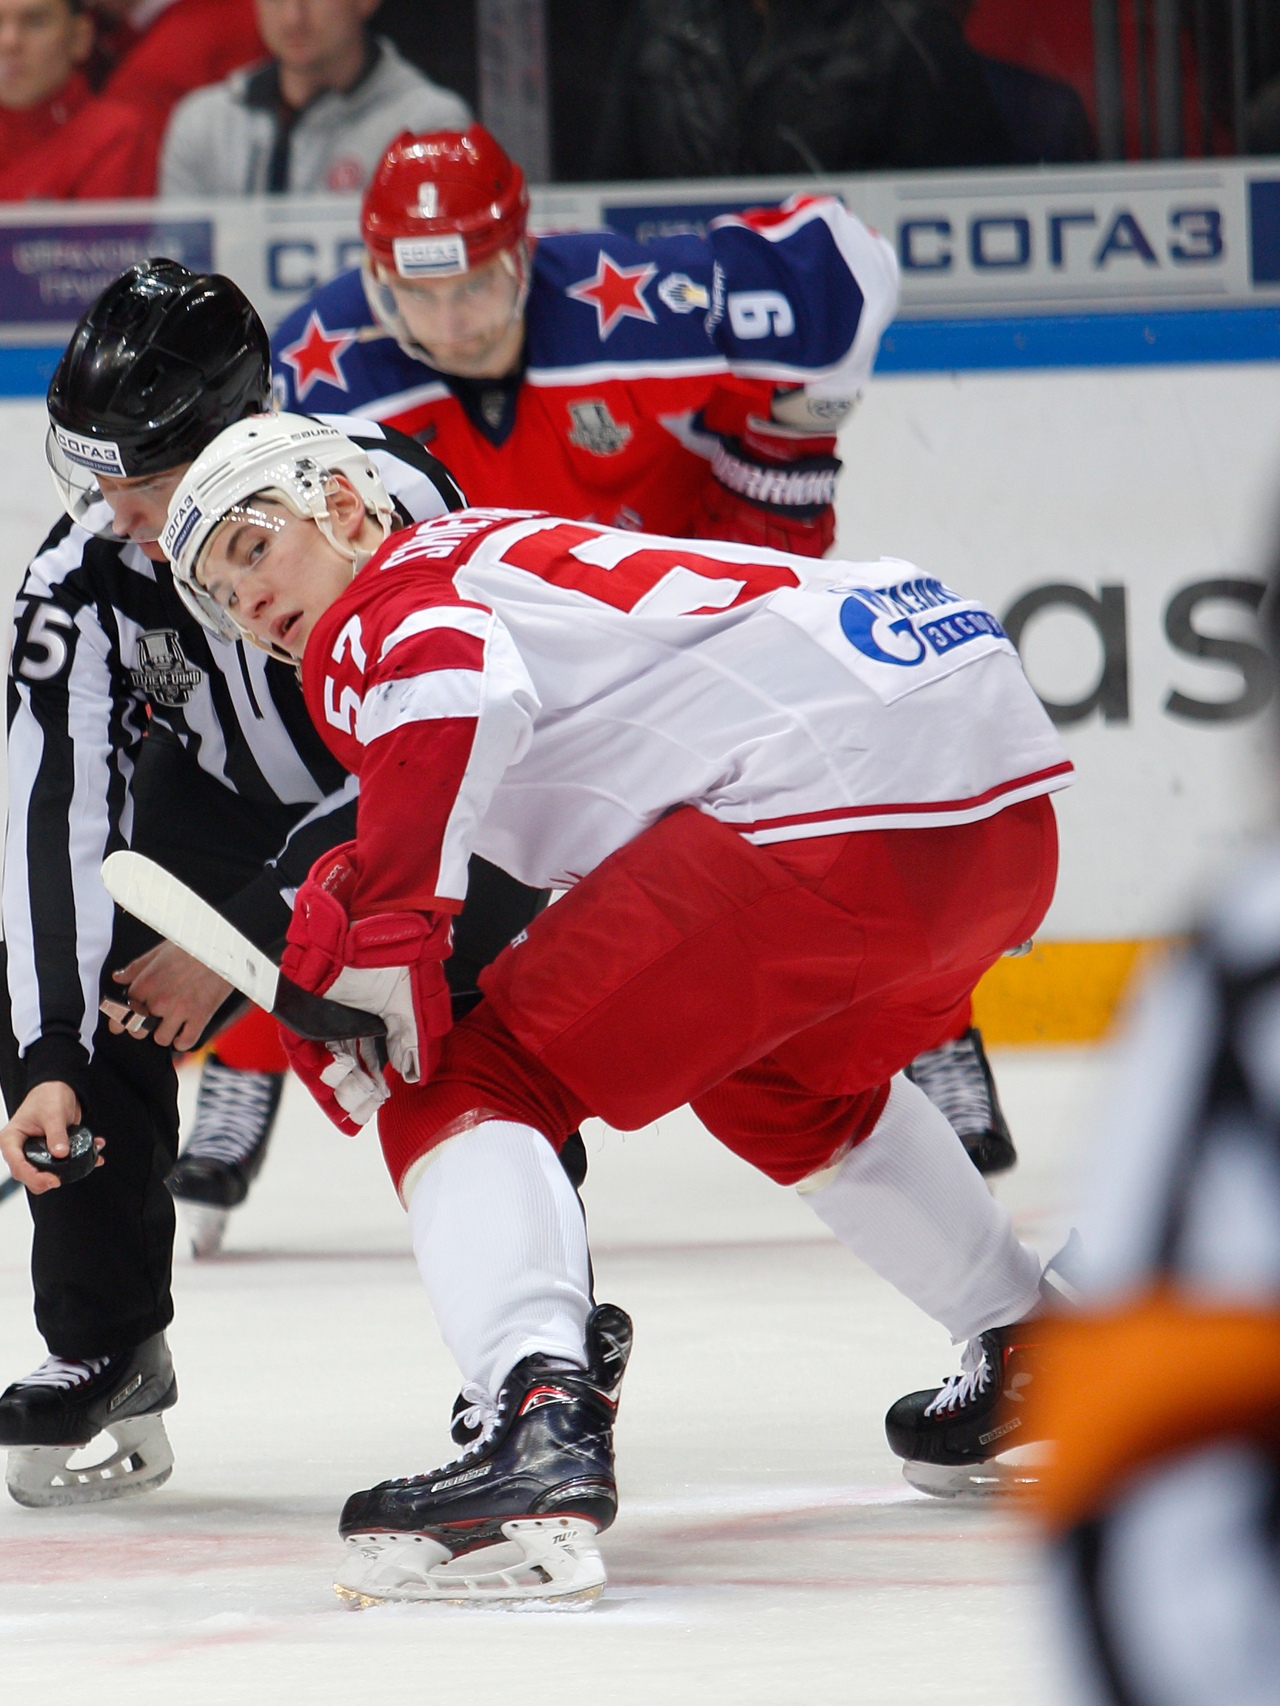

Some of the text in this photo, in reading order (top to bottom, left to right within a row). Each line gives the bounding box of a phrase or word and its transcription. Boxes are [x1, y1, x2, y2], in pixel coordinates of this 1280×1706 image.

[898, 207, 1226, 273] СОГАЗ
[57, 433, 118, 461] СОГАЗ
[165, 494, 194, 550] СОГАЗ
[10, 600, 73, 681] 5
[324, 613, 367, 736] 57
